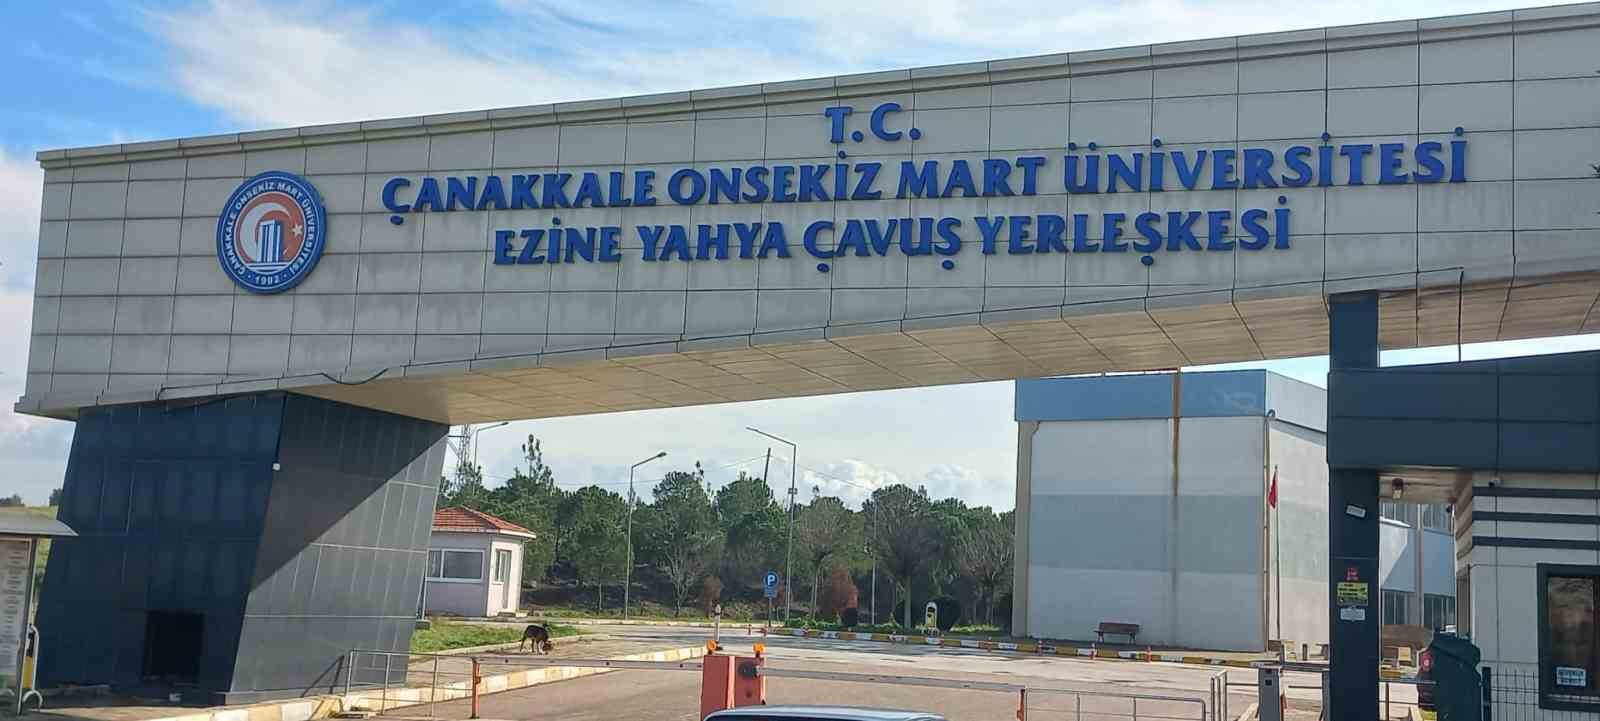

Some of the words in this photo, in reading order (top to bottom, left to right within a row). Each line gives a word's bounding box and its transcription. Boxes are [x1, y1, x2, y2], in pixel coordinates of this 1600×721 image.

[825, 102, 921, 144] T.C.
[277, 182, 304, 200] MART
[382, 170, 655, 224] ÇANAKKALE
[667, 150, 881, 206] ONSEKİZ
[895, 155, 1047, 199] MART
[1062, 126, 1469, 195] ÜNİVERSİTESİ
[492, 216, 624, 265] EZİNE
[636, 220, 791, 262] YAHYA
[802, 214, 960, 272] ÇAVUŞ
[975, 195, 1292, 267] YERLEŞKESİ
[767, 574, 776, 586] P
